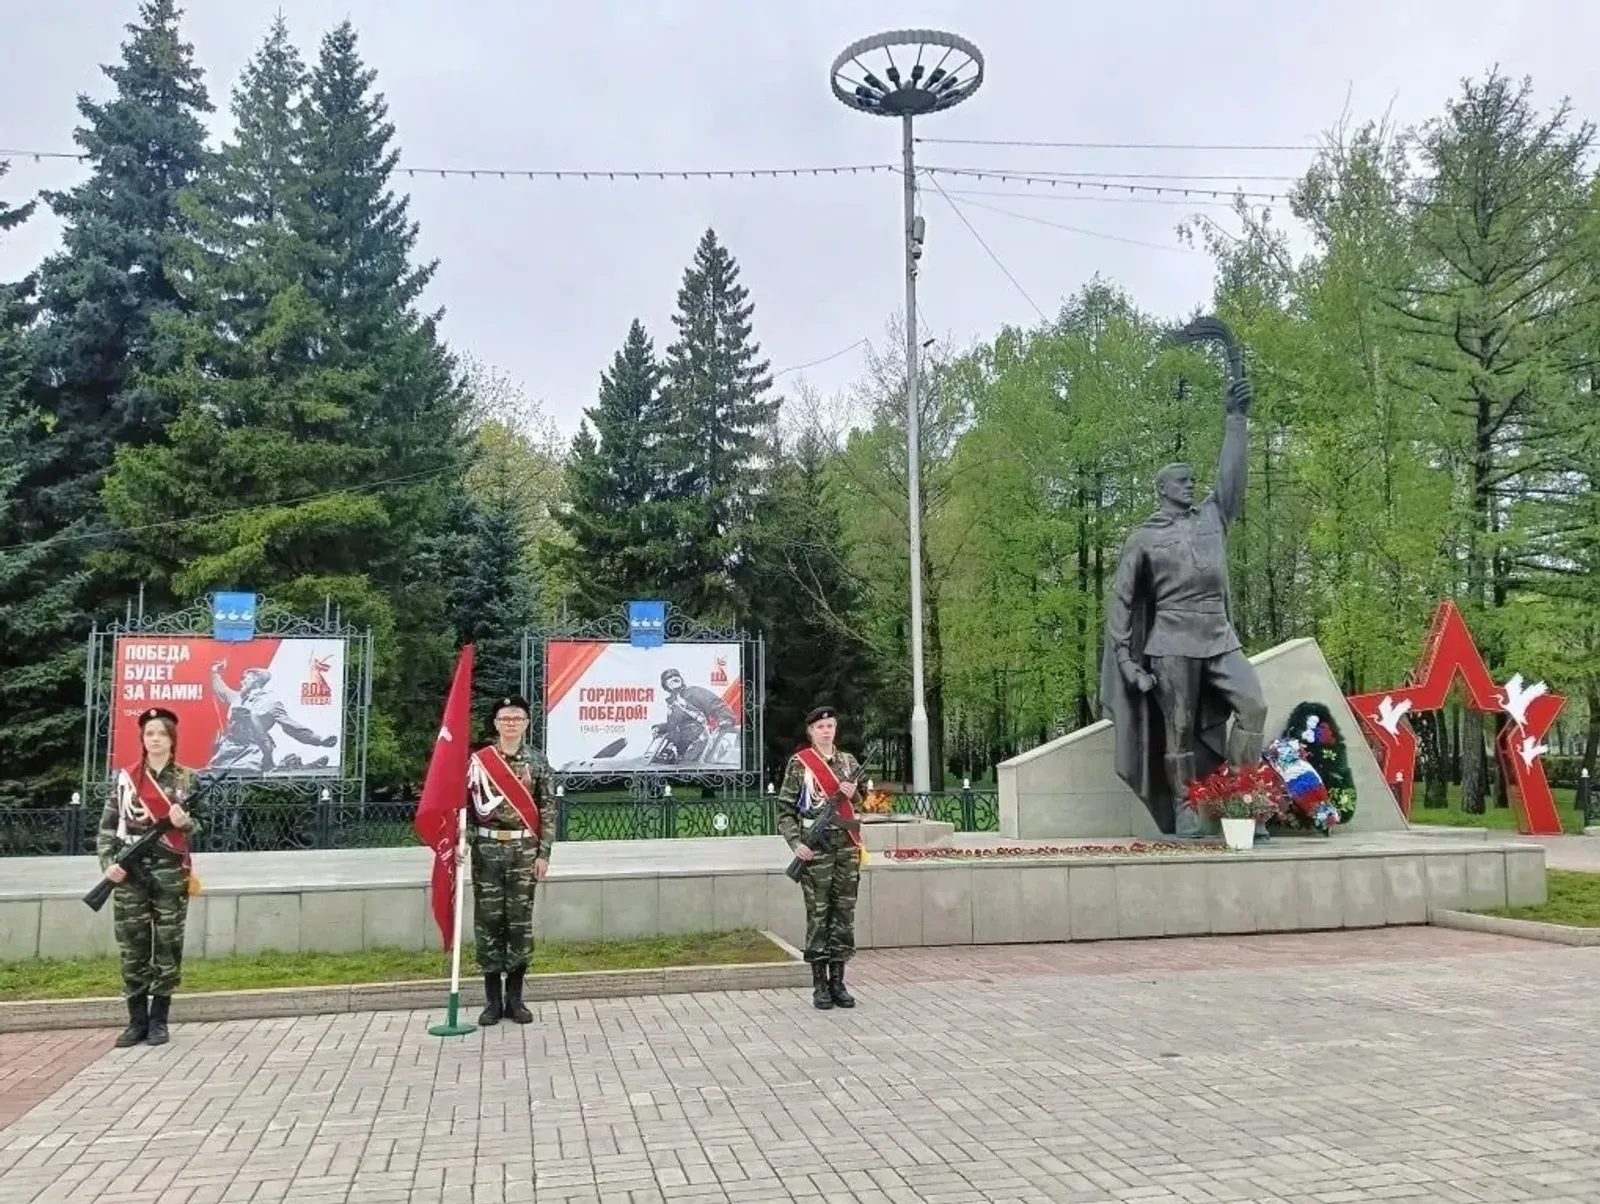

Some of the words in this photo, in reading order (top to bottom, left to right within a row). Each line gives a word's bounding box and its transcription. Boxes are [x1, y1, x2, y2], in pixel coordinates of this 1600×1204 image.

[125, 644, 190, 663] ПОБЕДА
[124, 664, 175, 683] БУДЕТ
[123, 684, 145, 700] ЗА
[150, 684, 203, 700] НАМИ!
[579, 688, 654, 704] ГОРДИМСЯ
[579, 705, 648, 722] ПОБЕДОЙ!
